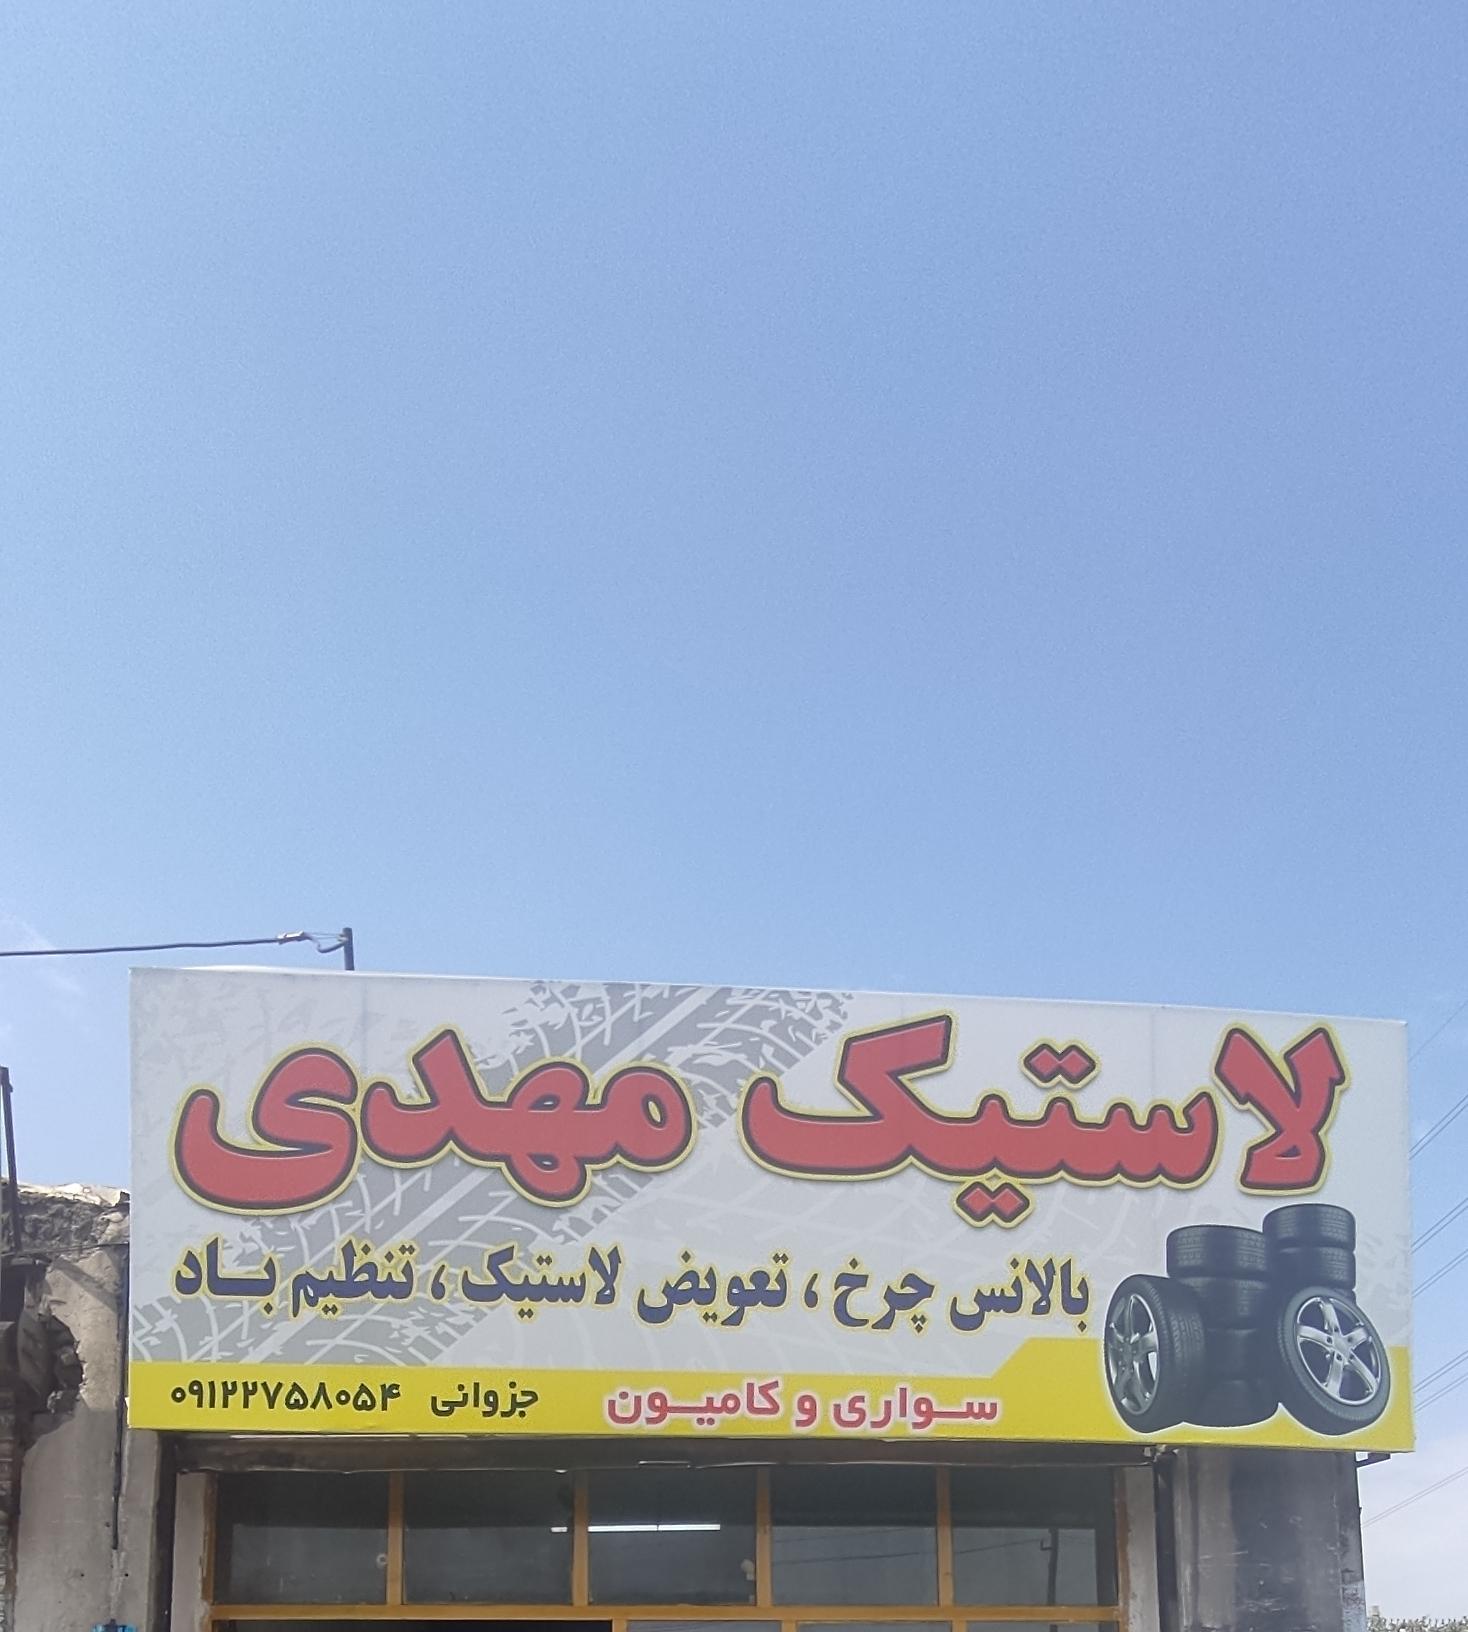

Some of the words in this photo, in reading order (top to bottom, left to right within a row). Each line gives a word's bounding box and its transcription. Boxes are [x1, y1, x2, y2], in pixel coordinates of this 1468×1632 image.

[174, 1026, 696, 1212] مهدی
[742, 1012, 1346, 1226] لاستیک
[291, 1239, 416, 1318] تنظیم
[461, 1244, 622, 1320] لاستیک
[637, 1250, 788, 1326] تعویض
[832, 1257, 936, 1334] چرخ
[949, 1257, 1090, 1334] بالانس
[170, 1379, 402, 1412] ۰۹۱۲۲۷۵۸۰۵۴
[430, 1380, 540, 1419] جزوانی
[794, 1393, 818, 1428] و
